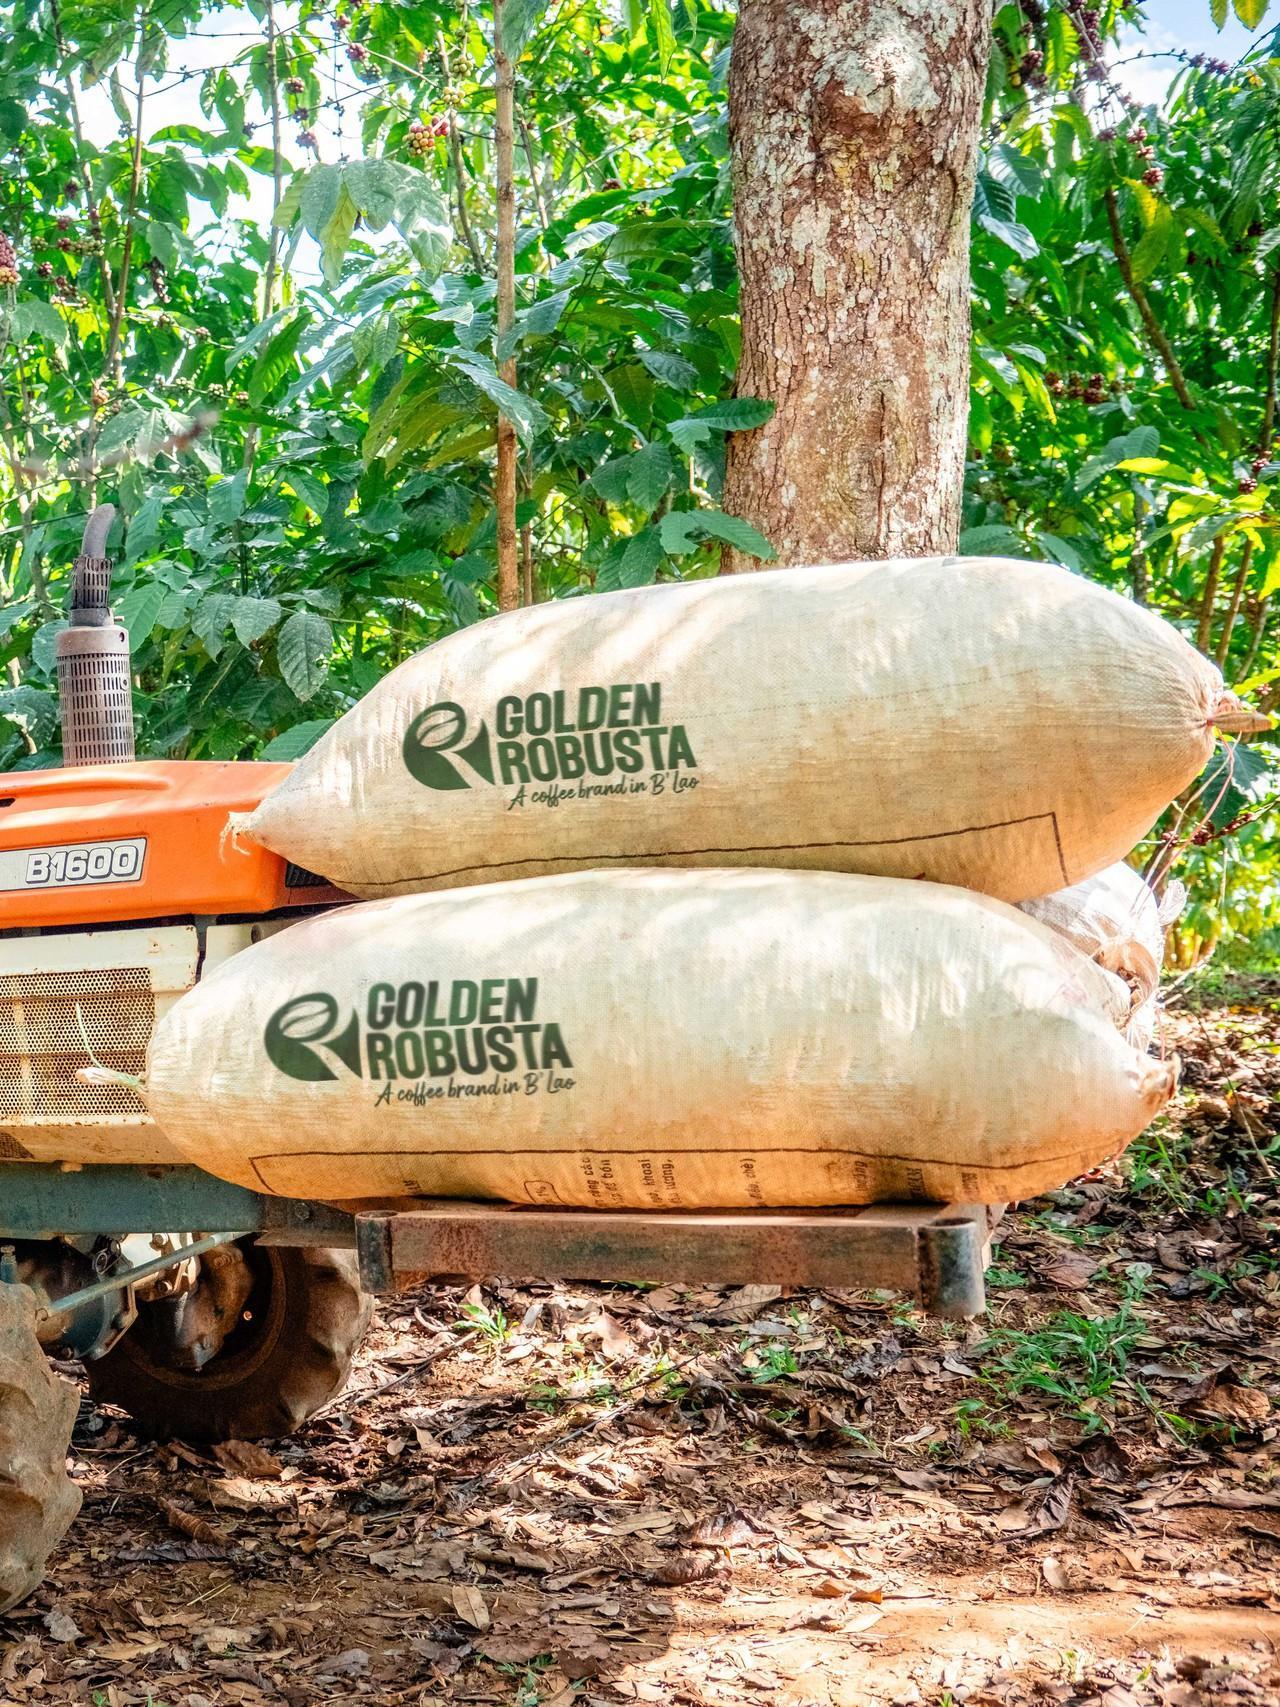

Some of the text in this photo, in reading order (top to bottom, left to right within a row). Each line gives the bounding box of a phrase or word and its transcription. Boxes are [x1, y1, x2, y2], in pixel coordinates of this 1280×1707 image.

[496, 682, 662, 740] GOLDEN
[497, 725, 698, 787] ROBUSTA
[507, 784, 527, 811] A
[531, 784, 575, 807] coffee
[578, 774, 627, 799] brand
[629, 776, 648, 794] in
[26, 844, 140, 885] B1600
[366, 976, 539, 1031] GOLDEN
[366, 1022, 573, 1081] ROBUSTA
[374, 1081, 394, 1107] A
[397, 1081, 445, 1107] coffee
[447, 1074, 500, 1099] brand
[503, 1077, 520, 1095] in
